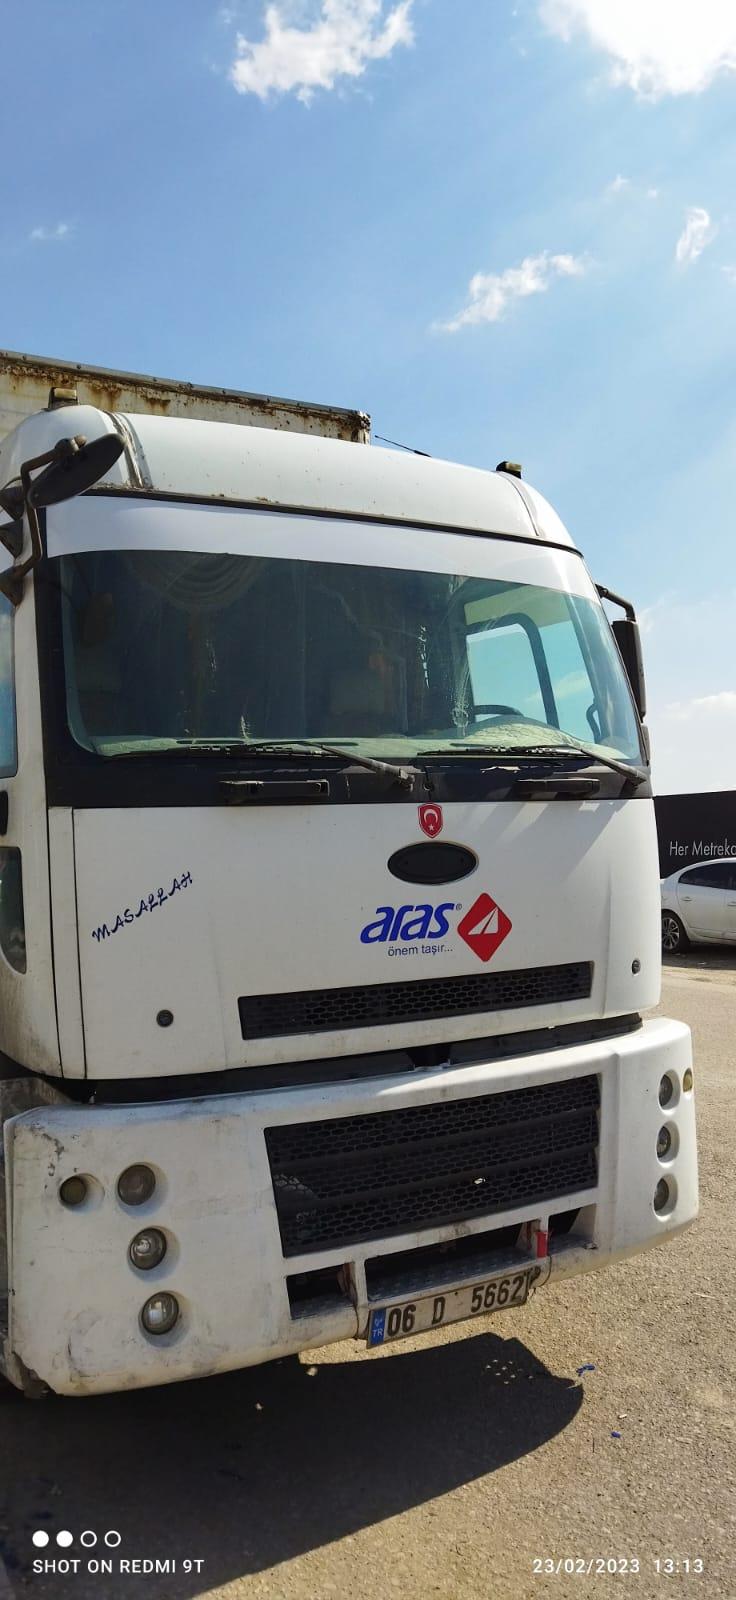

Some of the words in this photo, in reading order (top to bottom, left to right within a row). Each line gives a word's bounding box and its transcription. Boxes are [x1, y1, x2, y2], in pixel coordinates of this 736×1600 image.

[669, 840, 689, 856] Her
[388, 946, 419, 957] önem
[387, 1304, 416, 1336] 06
[431, 1296, 446, 1325] D
[371, 1328, 384, 1338] TR
